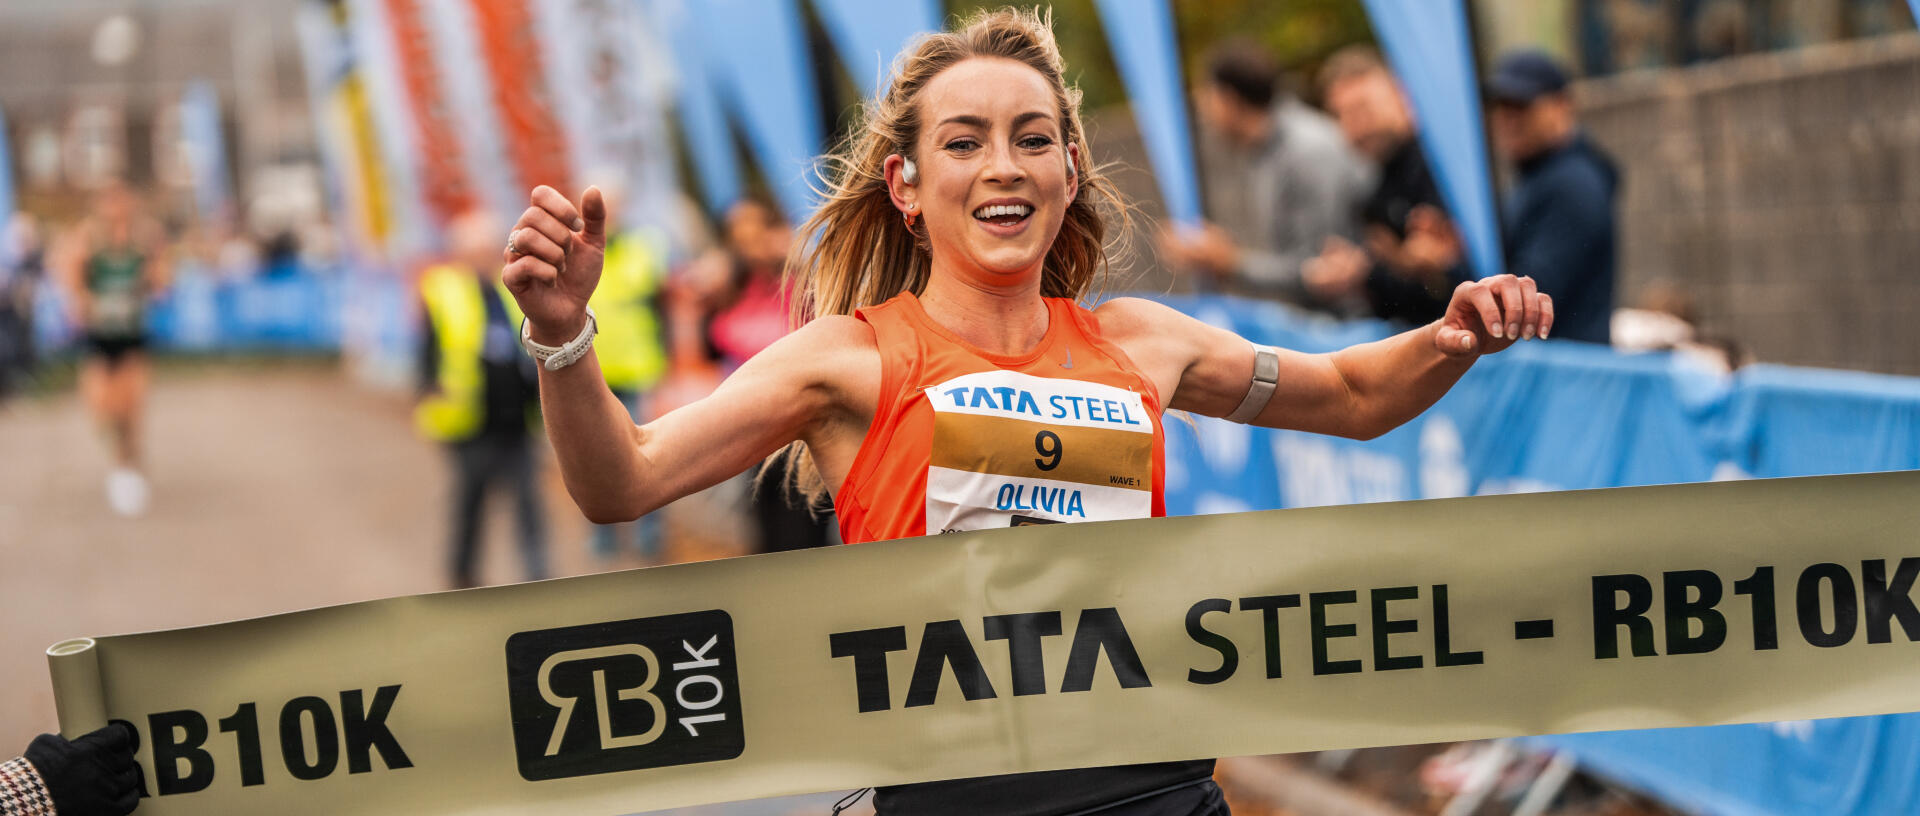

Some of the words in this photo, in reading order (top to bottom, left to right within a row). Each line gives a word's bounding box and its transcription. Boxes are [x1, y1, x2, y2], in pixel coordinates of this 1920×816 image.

[944, 386, 1042, 416] TATA
[1049, 395, 1141, 425] STEEL
[1034, 430, 1063, 472] 9
[996, 483, 1086, 518] OLIVIA
[1109, 475, 1134, 487] WAVE
[1136, 479, 1141, 487] 1
[829, 607, 1153, 713] TATA
[1185, 584, 1484, 685] STEEL
[1592, 556, 1920, 659] RB10K
